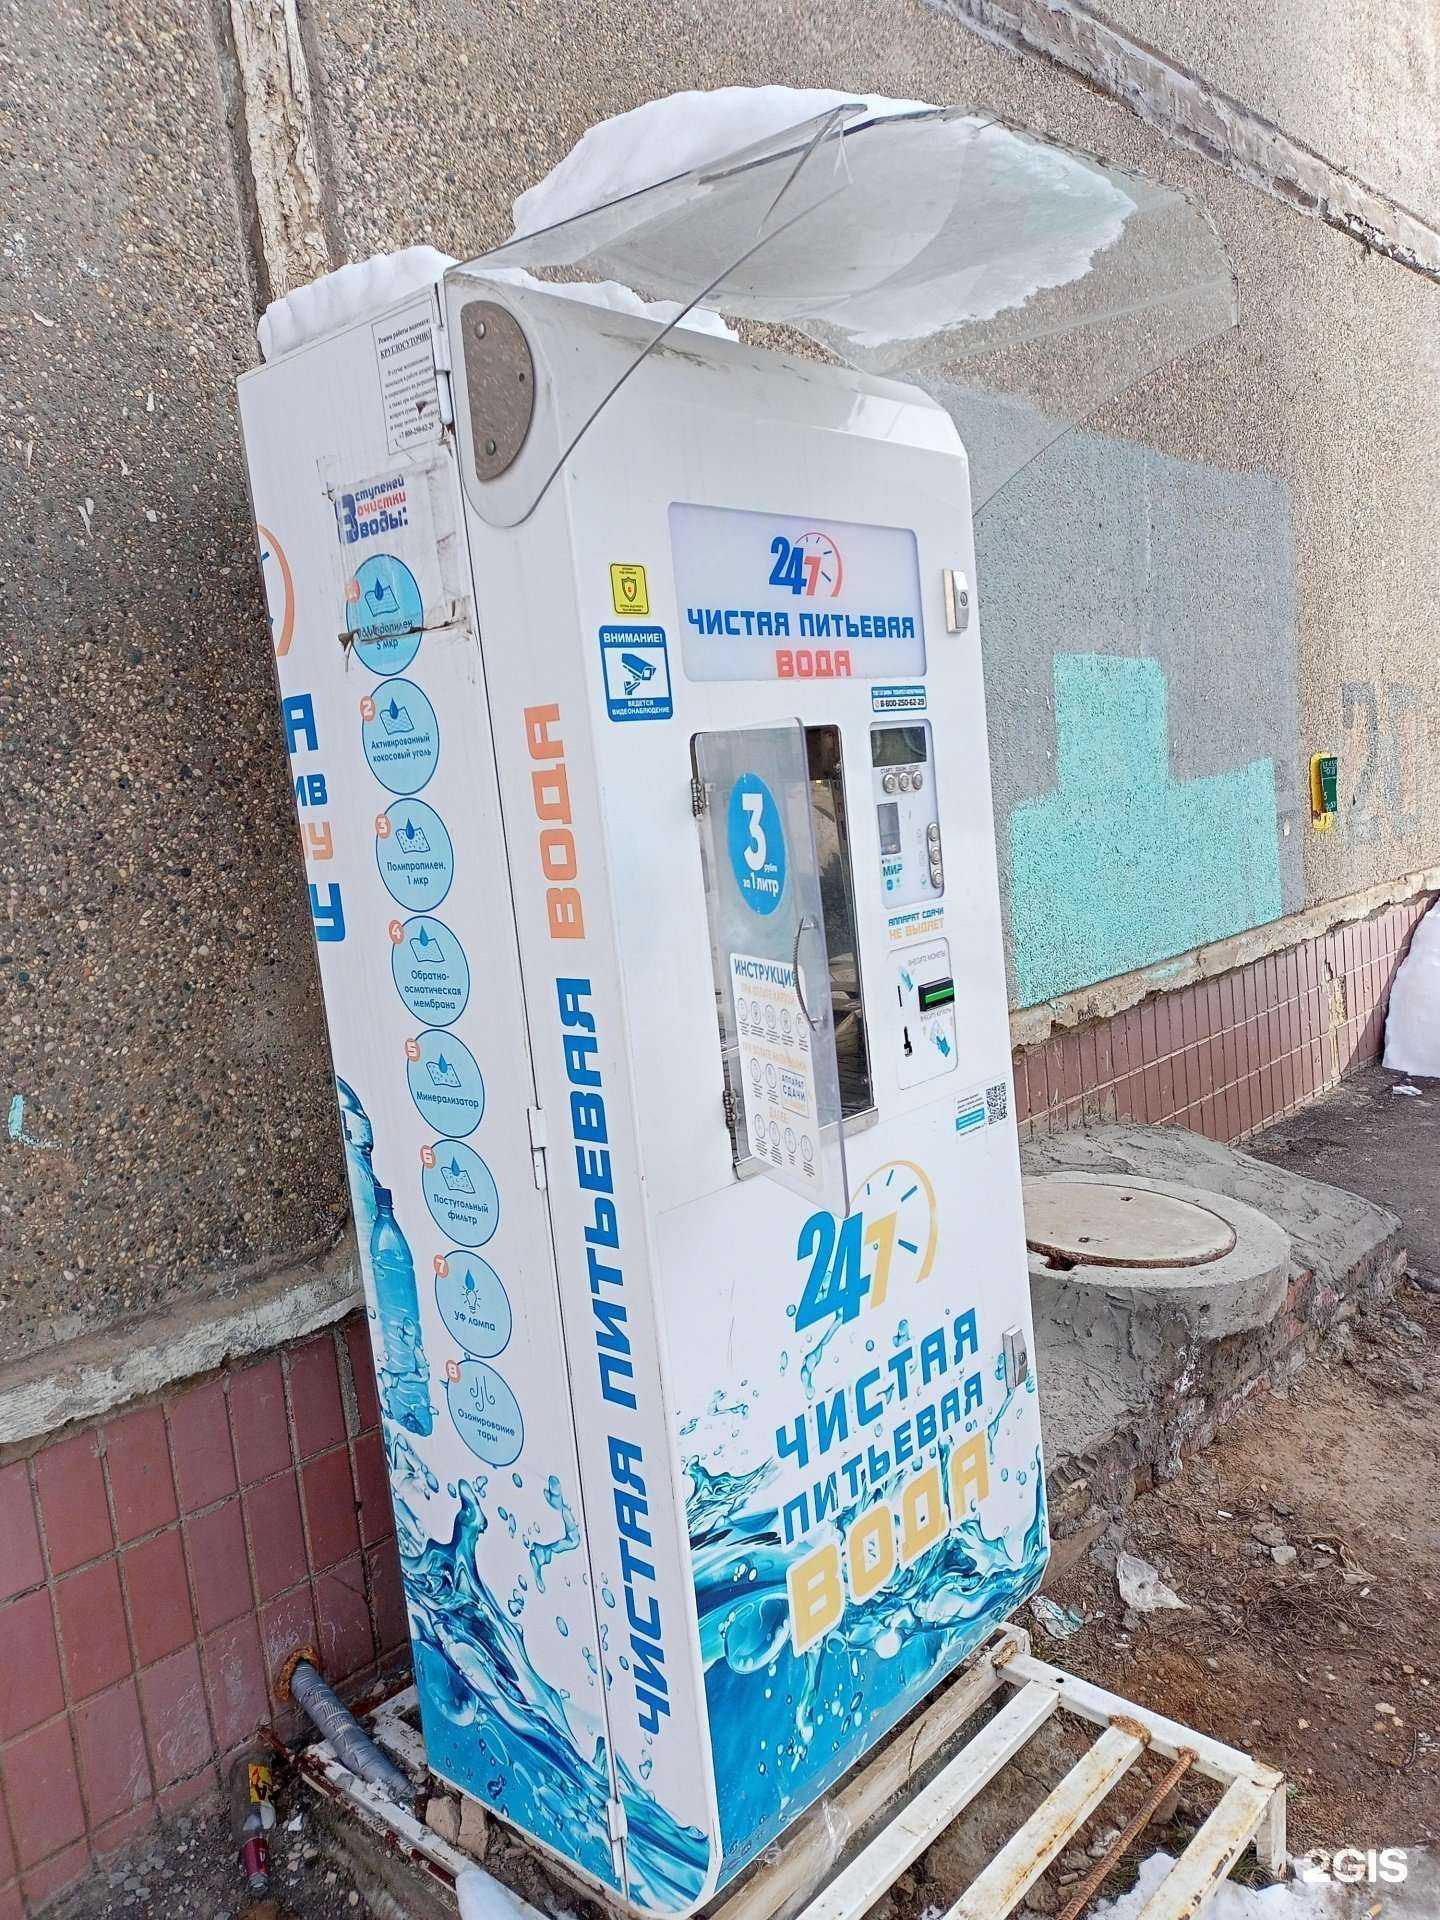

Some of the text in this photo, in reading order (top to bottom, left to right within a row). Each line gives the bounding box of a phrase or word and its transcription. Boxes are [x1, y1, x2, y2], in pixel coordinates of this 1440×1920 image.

[355, 475, 405, 500] ступеней
[357, 491, 406, 517] очистки
[357, 507, 408, 539] воды:
[687, 608, 915, 639] ЧИСТАЯ ПИТЬЕВАЯ
[376, 638, 399, 651] 5 мкр
[603, 632, 663, 644] ВНИМАНИЕ!
[775, 649, 852, 678] ВОДА
[612, 706, 670, 716] ВИДЕОНАБЛЮДЕНИЕ
[628, 699, 654, 707] ВЕДЕТСЯ
[371, 732, 431, 749] Активированный
[373, 747, 431, 762] кокосовый уголь
[741, 793, 767, 871] 3
[387, 860, 446, 873] Полипропилен,
[883, 863, 903, 877] МИР
[413, 875, 429, 887] мкр
[751, 872, 756, 889] 1
[756, 877, 779, 897] литр
[411, 969, 450, 982] Обратно-
[404, 984, 462, 996] осмотическая
[413, 998, 456, 1010] мембрана
[416, 1091, 479, 1108] Минерализатор
[433, 1193, 489, 1213] Постугольный
[447, 1209, 478, 1226] фильтр
[524, 703, 671, 1734] ЧИСТАЯ ПИТЬЕВАЯ ВОДА
[468, 1316, 496, 1331] лампа
[776, 1307, 980, 1469] ЧИСТАЯ
[457, 1408, 516, 1436] Озонирование
[477, 1427, 499, 1443] тары
[783, 1371, 984, 1545] ПИТЬЕВАЯ
[788, 1428, 991, 1655] ВОДА
